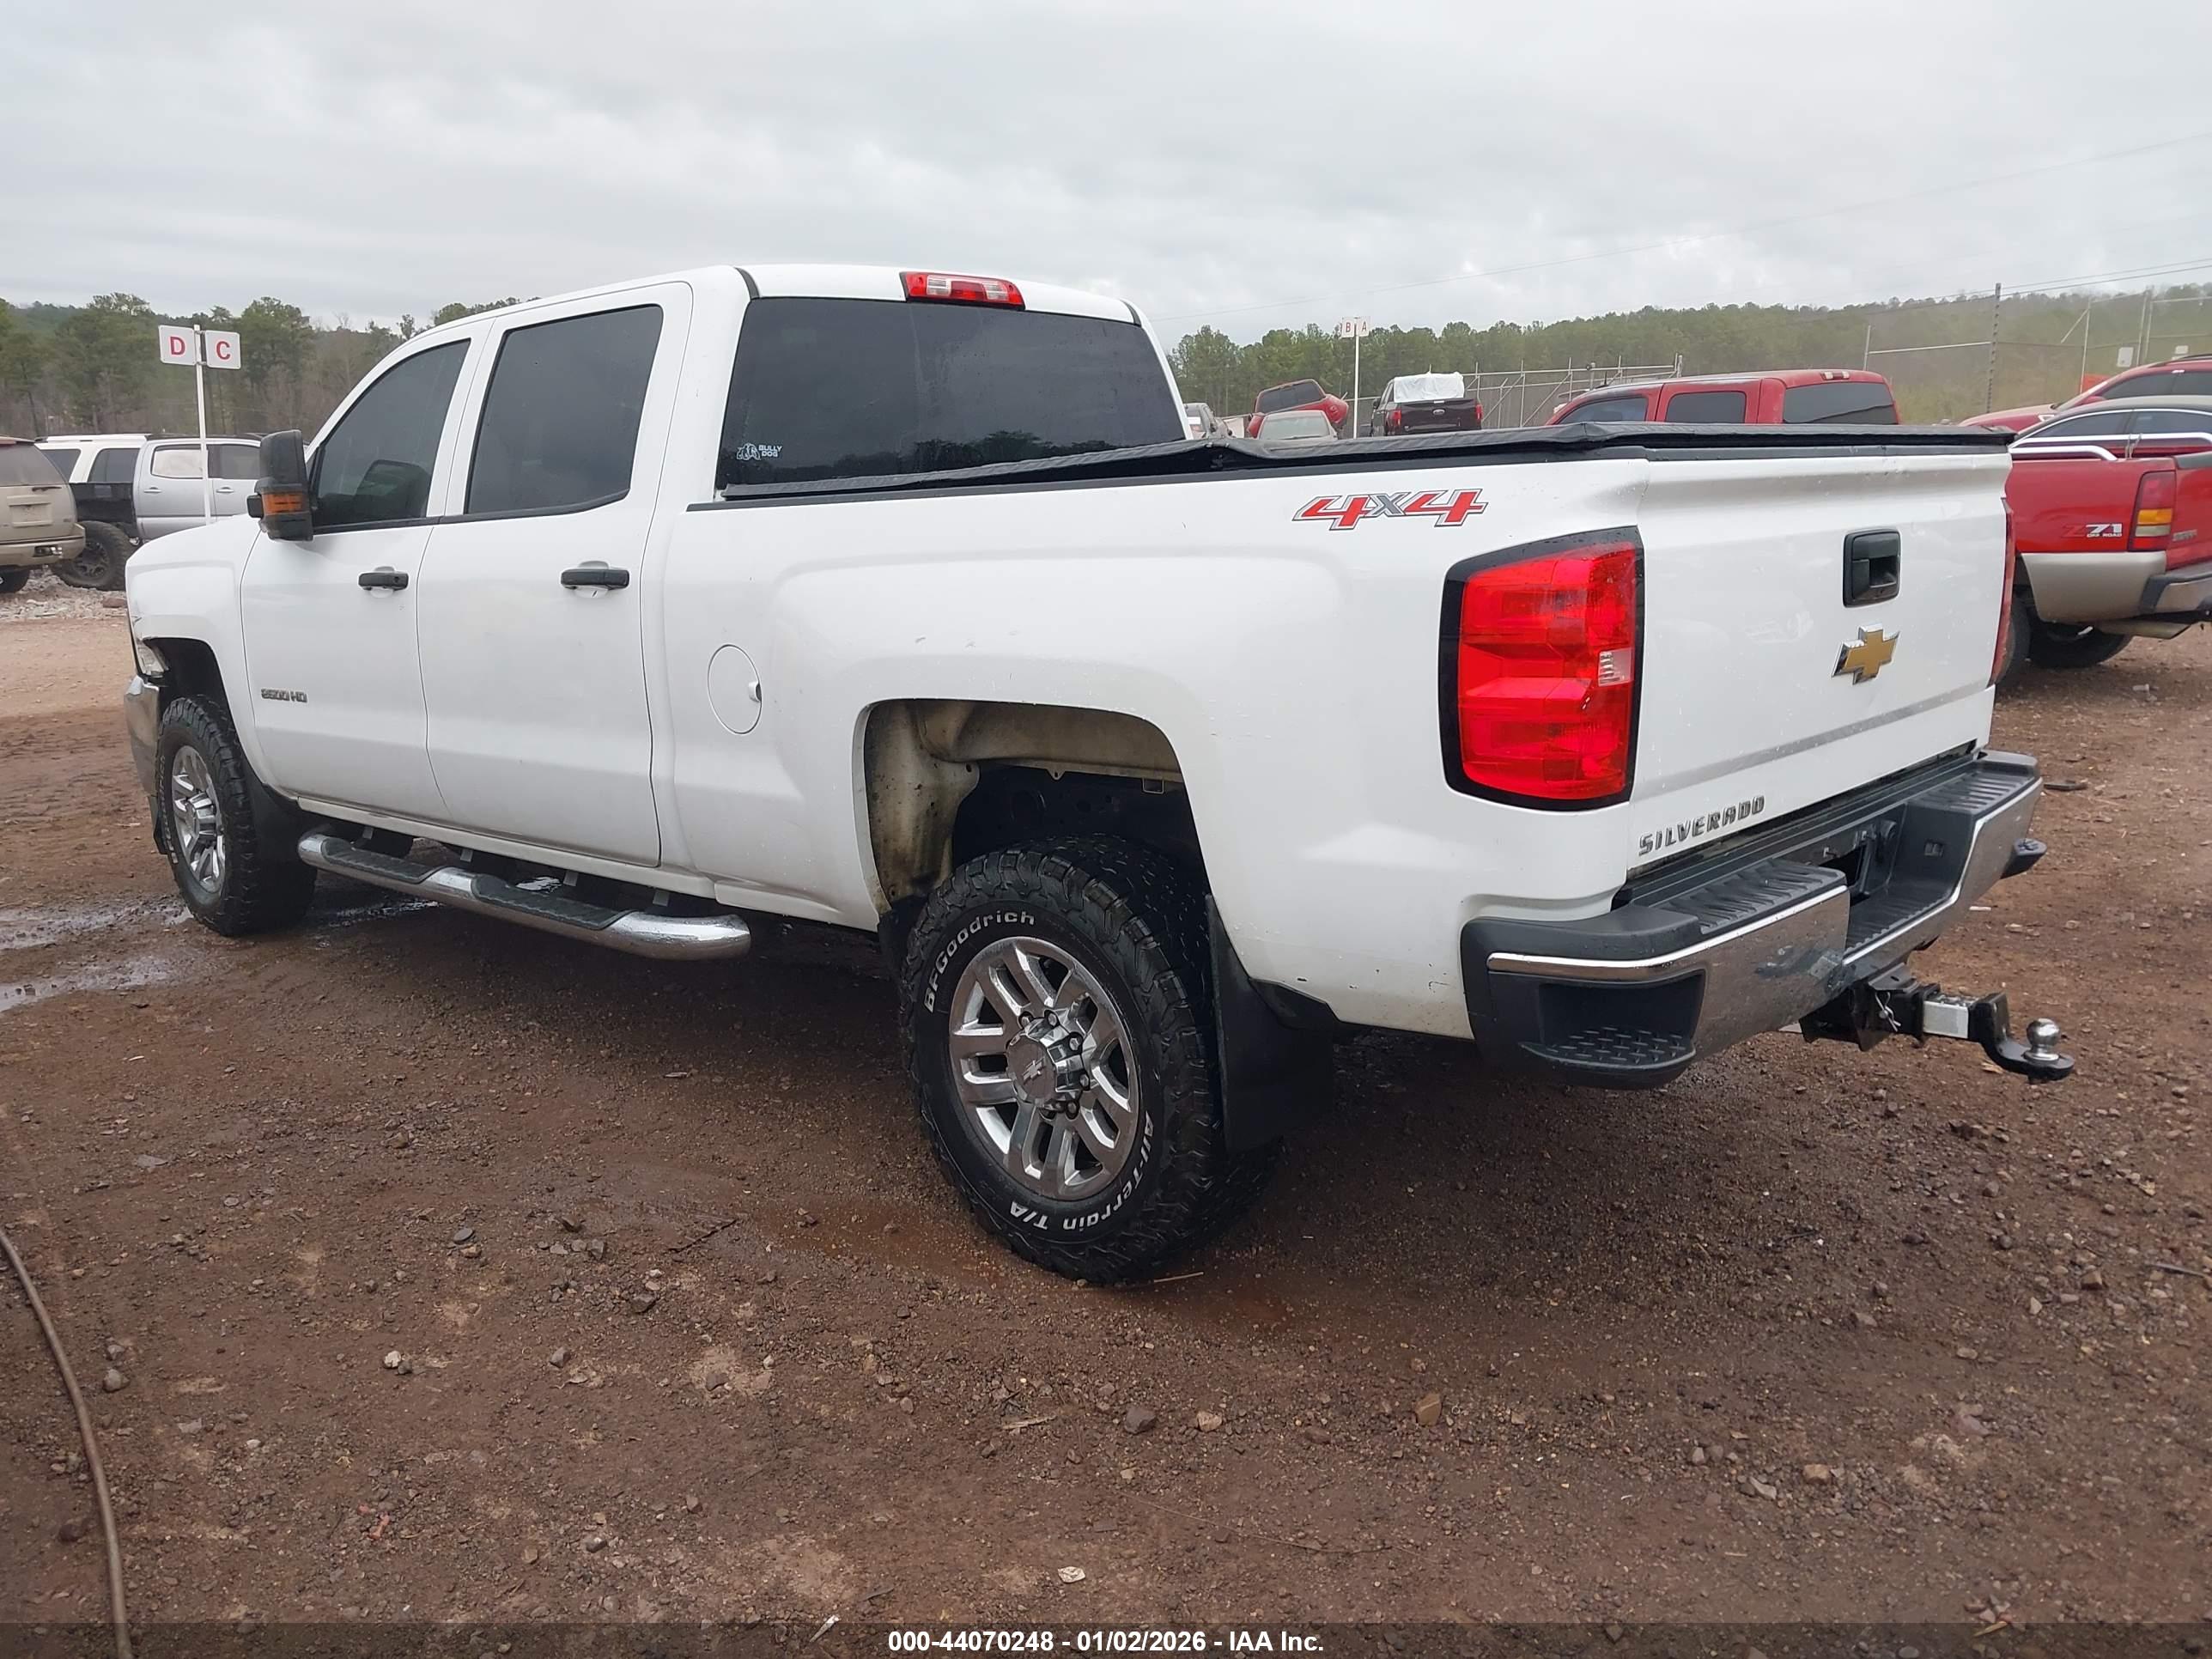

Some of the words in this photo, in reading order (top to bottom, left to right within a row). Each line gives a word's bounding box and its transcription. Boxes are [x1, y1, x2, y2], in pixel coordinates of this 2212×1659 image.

[1346, 321, 1352, 333] B
[1361, 320, 1367, 332] A
[169, 336, 185, 356] D
[216, 340, 231, 361] C
[1638, 794, 1765, 857] SILVERADO
[923, 909, 1036, 1014] BFGoodrich
[1009, 1201, 1049, 1231] T/A
